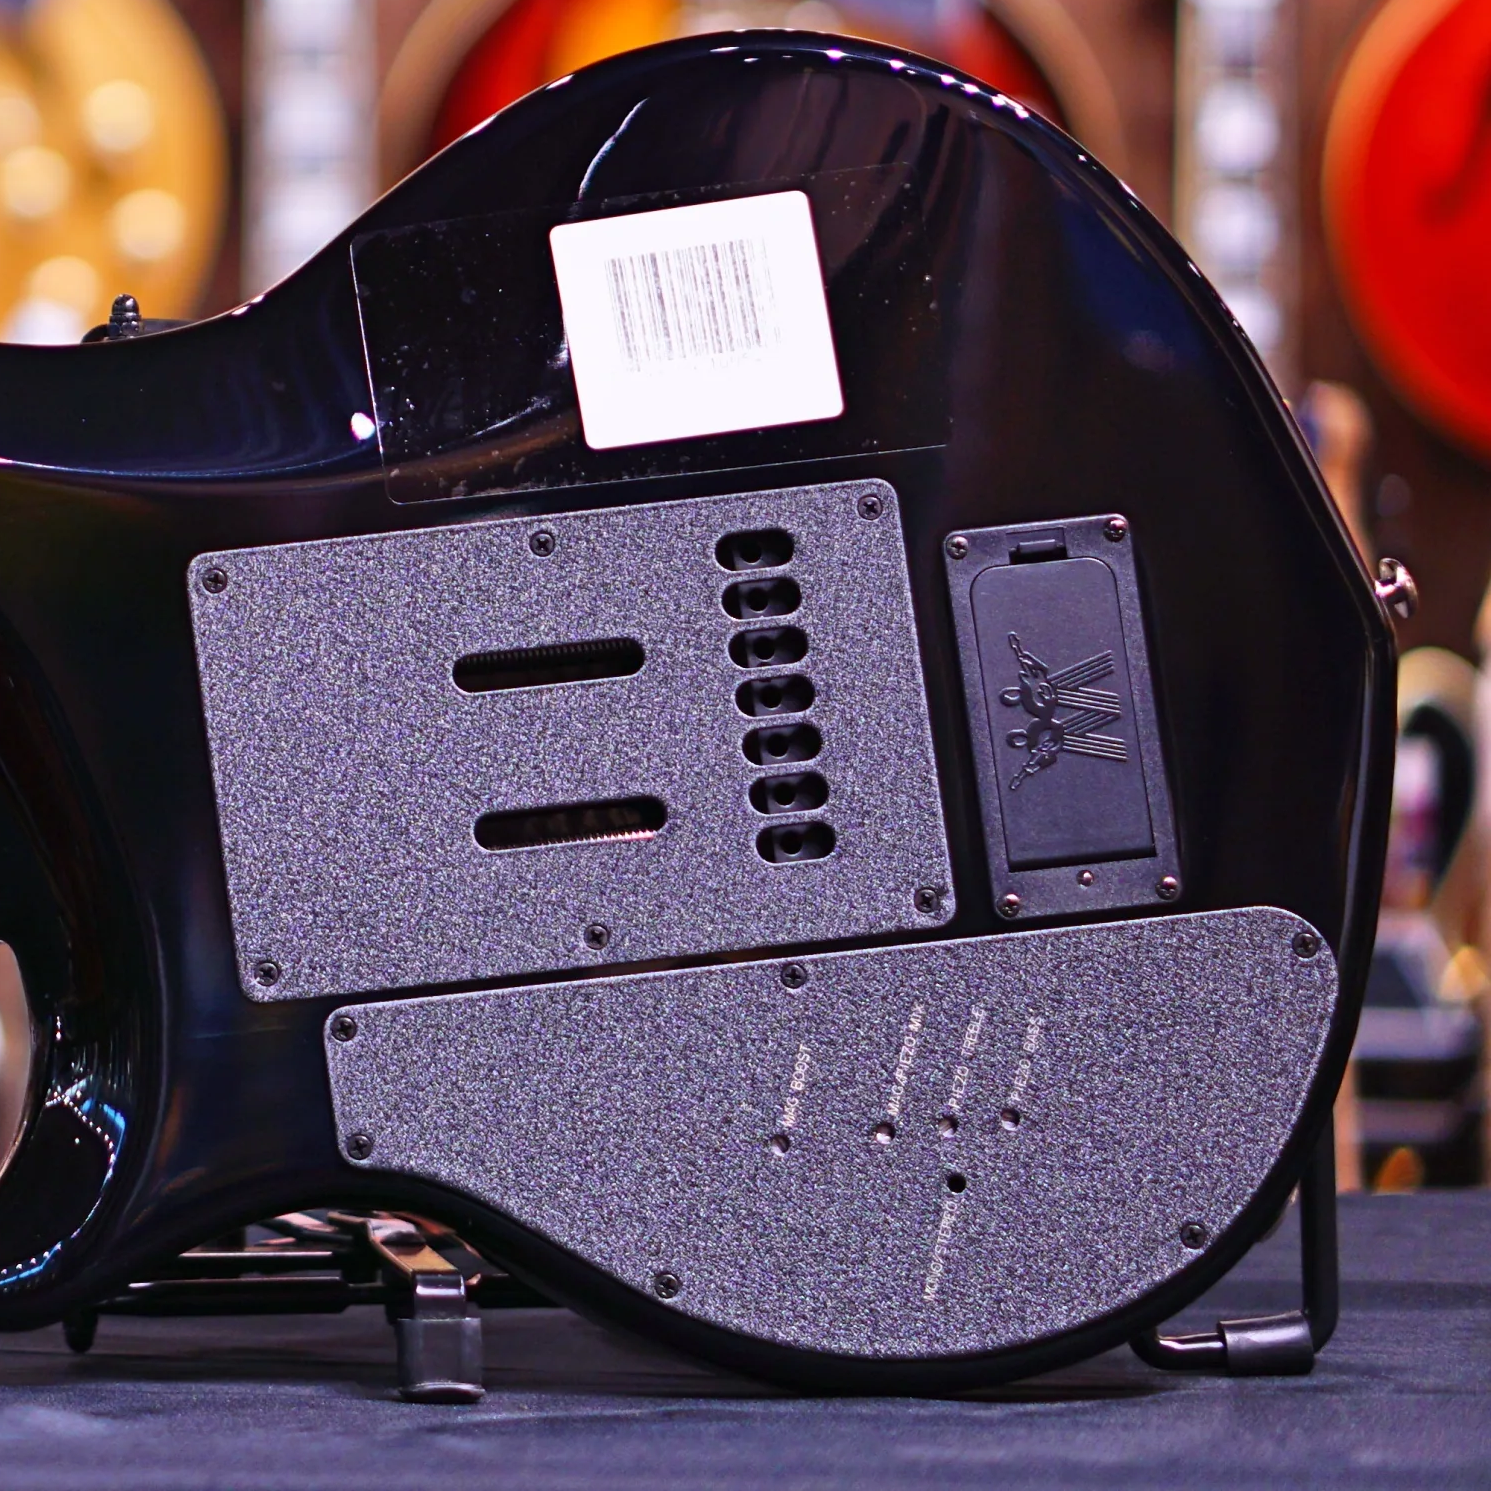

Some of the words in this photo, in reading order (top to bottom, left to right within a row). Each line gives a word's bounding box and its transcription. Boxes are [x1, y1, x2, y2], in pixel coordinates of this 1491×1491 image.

[908, 1003, 925, 1032] MIX
[790, 1043, 812, 1091] BOOST
[948, 1065, 970, 1109] PIEZO
[961, 1004, 986, 1056] TREBLE
[1010, 1059, 1031, 1101] PIEZO
[1023, 1016, 1044, 1052] BASS
[782, 1097, 799, 1127] MAG
